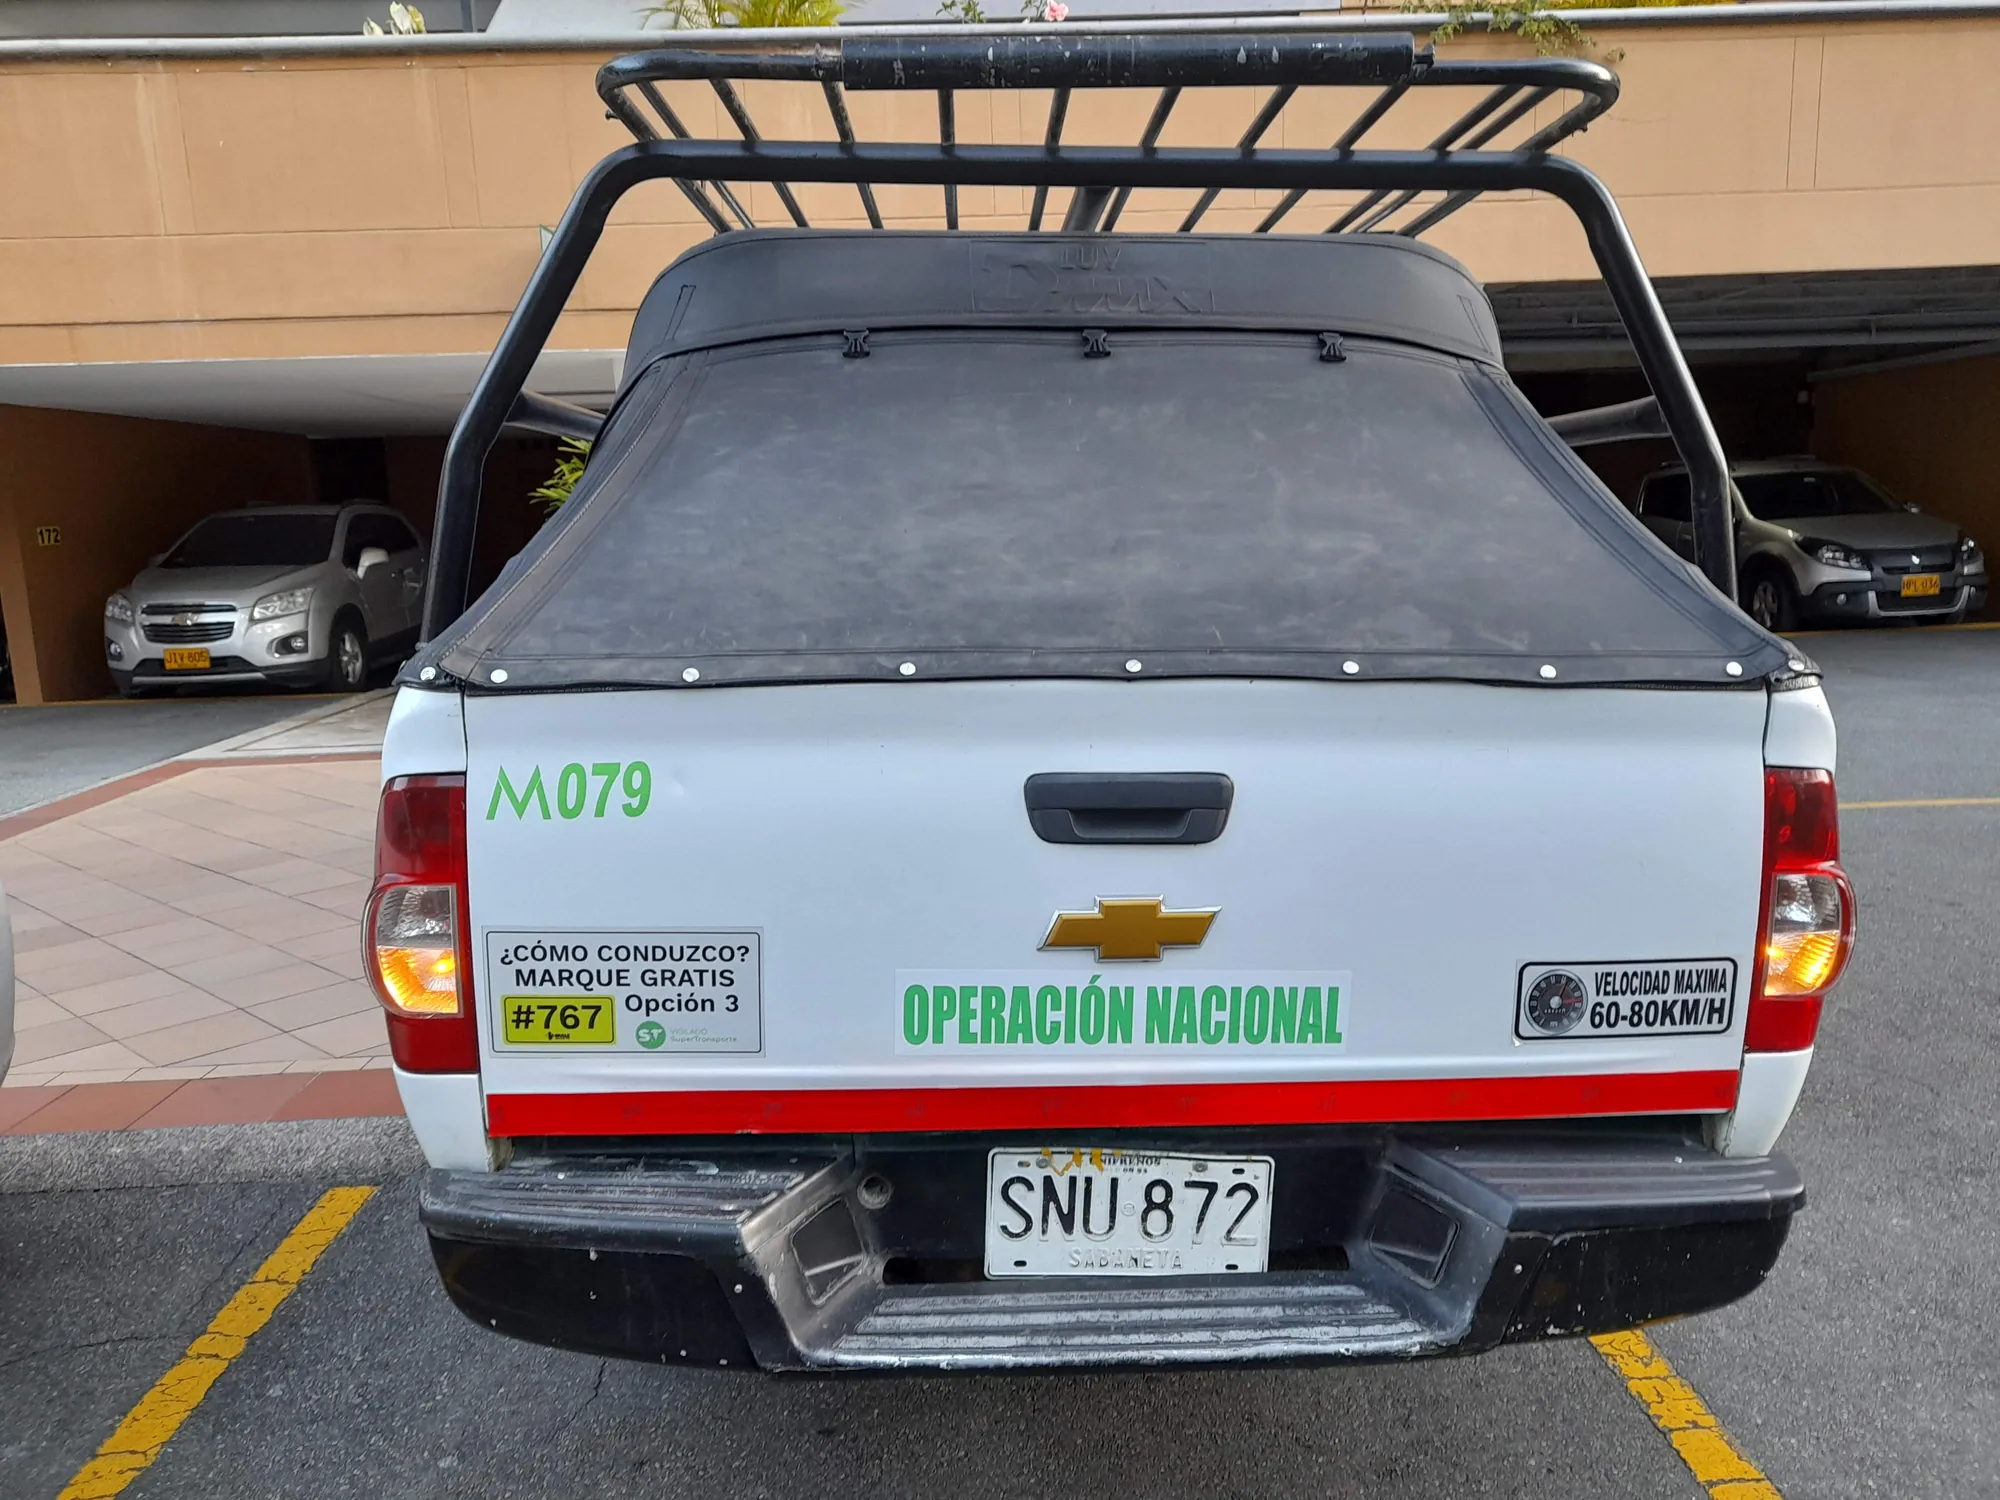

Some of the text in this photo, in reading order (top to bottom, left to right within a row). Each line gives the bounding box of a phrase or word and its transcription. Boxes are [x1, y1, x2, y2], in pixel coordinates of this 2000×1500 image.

[39, 528, 60, 544] 172
[486, 761, 652, 821] M079
[500, 940, 750, 965] ¿CÓMO CONDUZCO?
[515, 968, 735, 991] MARQUE GRATIS
[1595, 968, 1727, 998] VELOCIDAD MAXIMA
[511, 1005, 602, 1029] #767
[624, 993, 740, 1017] Opción 3
[903, 975, 1343, 1045] OPERACIÓN NACIONAL
[1590, 998, 1726, 1029] 60-80KM/H
[1000, 1175, 1260, 1246] SNU 872
[1069, 1248, 1184, 1269] SABANETA
